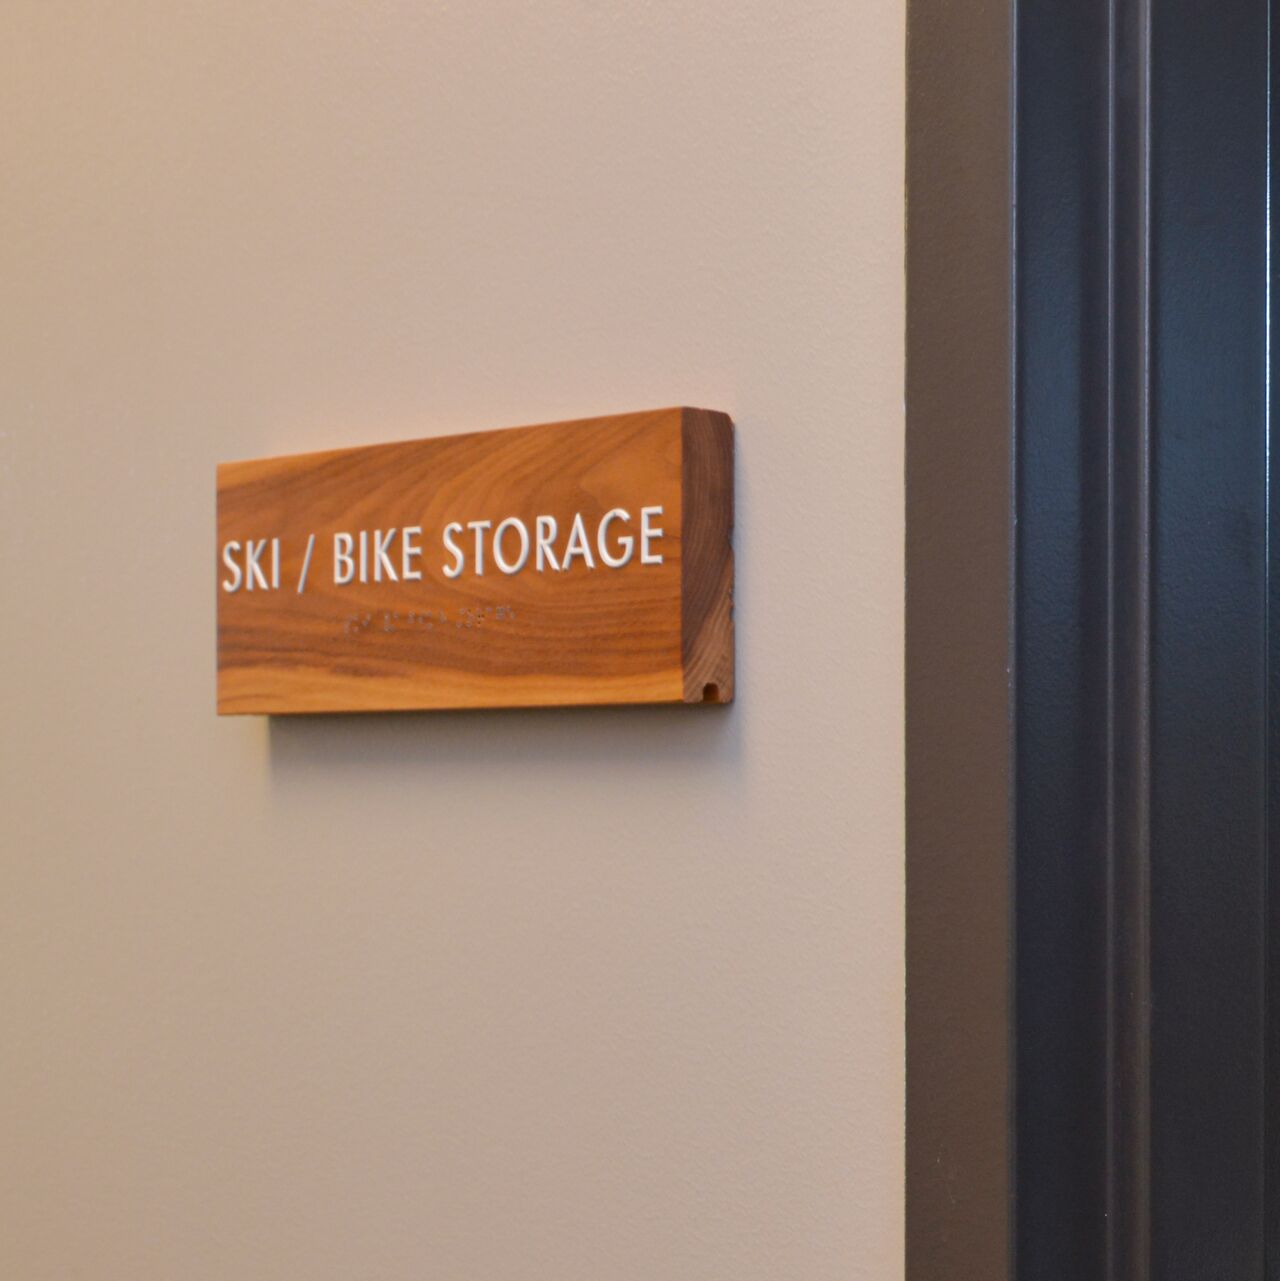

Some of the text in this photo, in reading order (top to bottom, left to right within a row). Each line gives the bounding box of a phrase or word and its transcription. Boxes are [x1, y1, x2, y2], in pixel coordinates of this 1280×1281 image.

[222, 505, 664, 595] SKI / BIKE STORAGE
